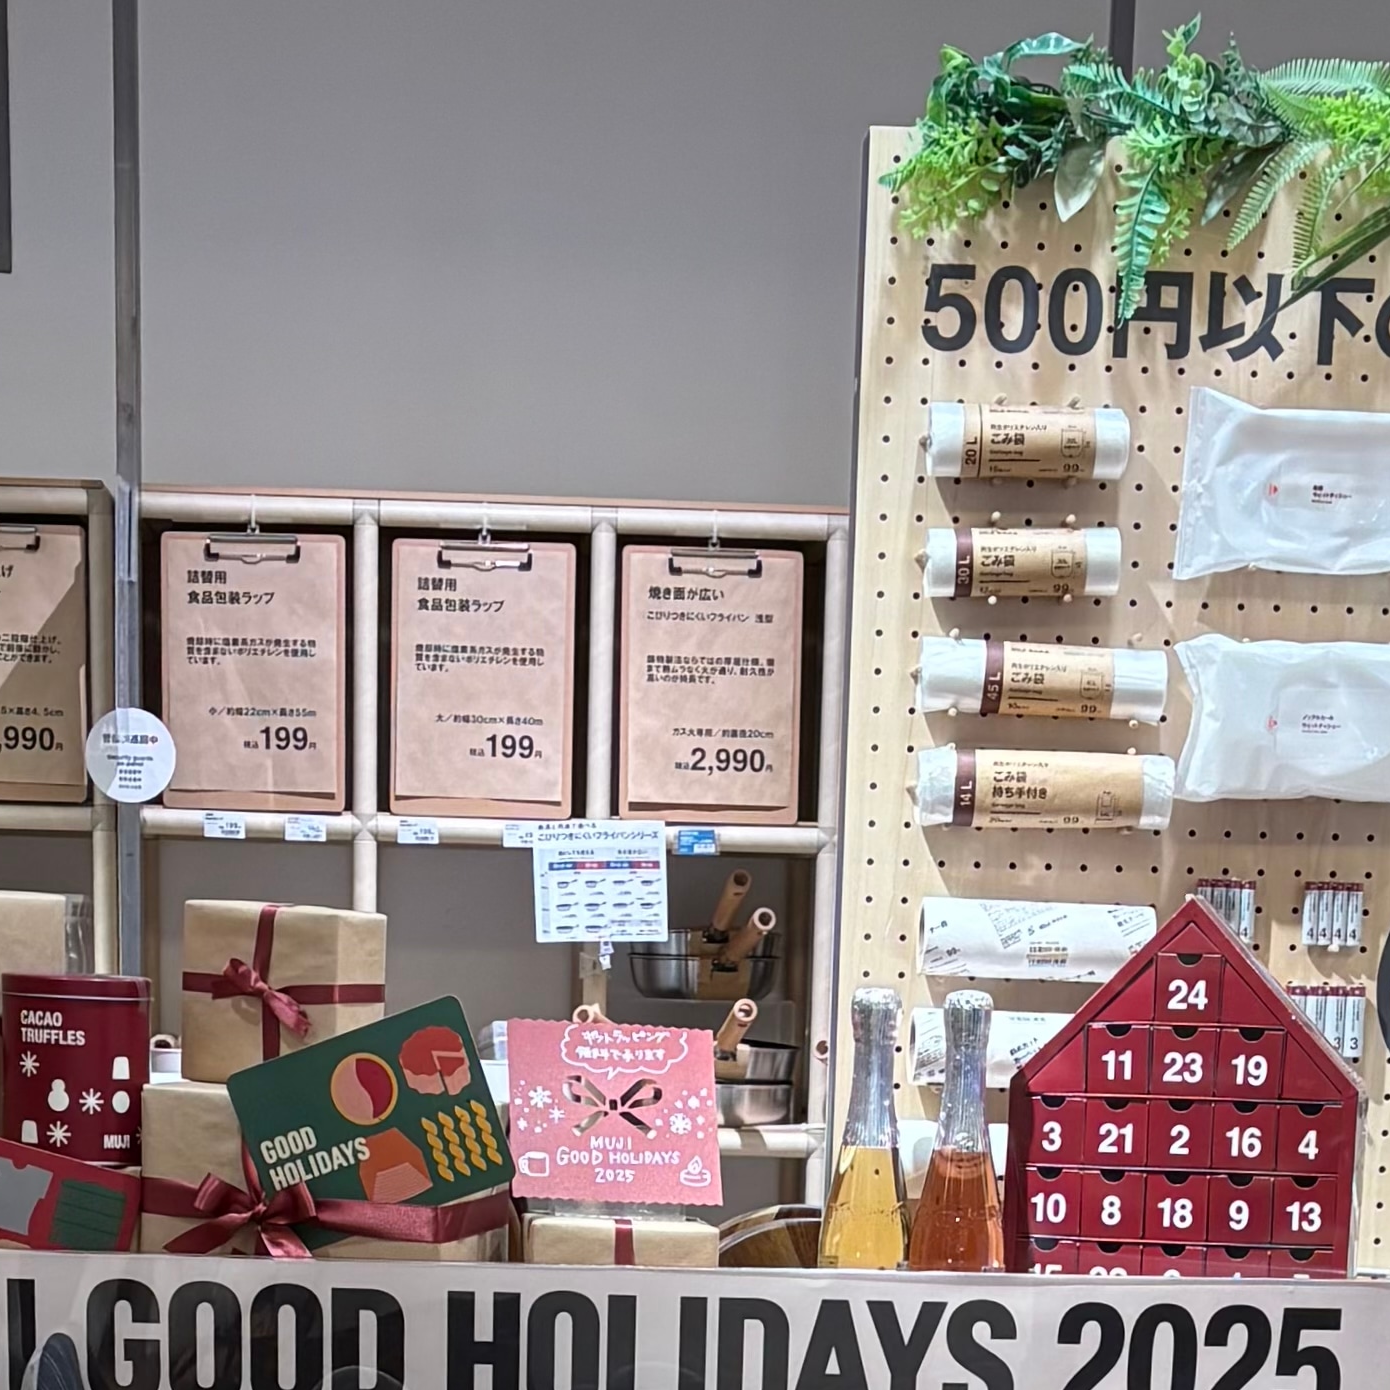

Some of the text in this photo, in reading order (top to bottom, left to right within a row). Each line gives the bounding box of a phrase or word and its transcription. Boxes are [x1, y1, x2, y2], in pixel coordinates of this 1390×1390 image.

[186, 570, 228, 585] 詰替用
[417, 576, 458, 592] 詰替用
[186, 590, 276, 606] 食品包装ラップ
[417, 597, 506, 613] 食品包装ラップ
[647, 585, 726, 602] 焼き面が広い
[243, 725, 318, 751] 税込199円
[469, 734, 543, 760] 税込199円
[674, 746, 775, 776] 税込2,990円
[1167, 979, 1208, 1011] 24
[20, 1009, 63, 1028] CACAO
[20, 1027, 86, 1047] TRUFFLES
[1100, 1051, 1133, 1081] 11
[1163, 1053, 1204, 1084] 23
[1230, 1054, 1269, 1087] 19
[103, 1133, 131, 1150] MUJI
[259, 1125, 318, 1165] GOOD
[590, 1135, 632, 1151] MUJI
[1041, 1122, 1063, 1152] 3
[1098, 1123, 1135, 1154] 21
[1170, 1125, 1190, 1156] 2
[1225, 1127, 1263, 1158] 16
[1298, 1130, 1320, 1160] 4
[267, 1136, 371, 1192] HOLIDAYS
[556, 1145, 681, 1166] GOOD HOLIDAYS
[594, 1167, 636, 1184] 2025
[1031, 1193, 1067, 1224] 10
[1101, 1195, 1122, 1226] 8
[1158, 1197, 1194, 1228] 18
[1228, 1199, 1250, 1231] 9
[1285, 1201, 1323, 1232] 13
